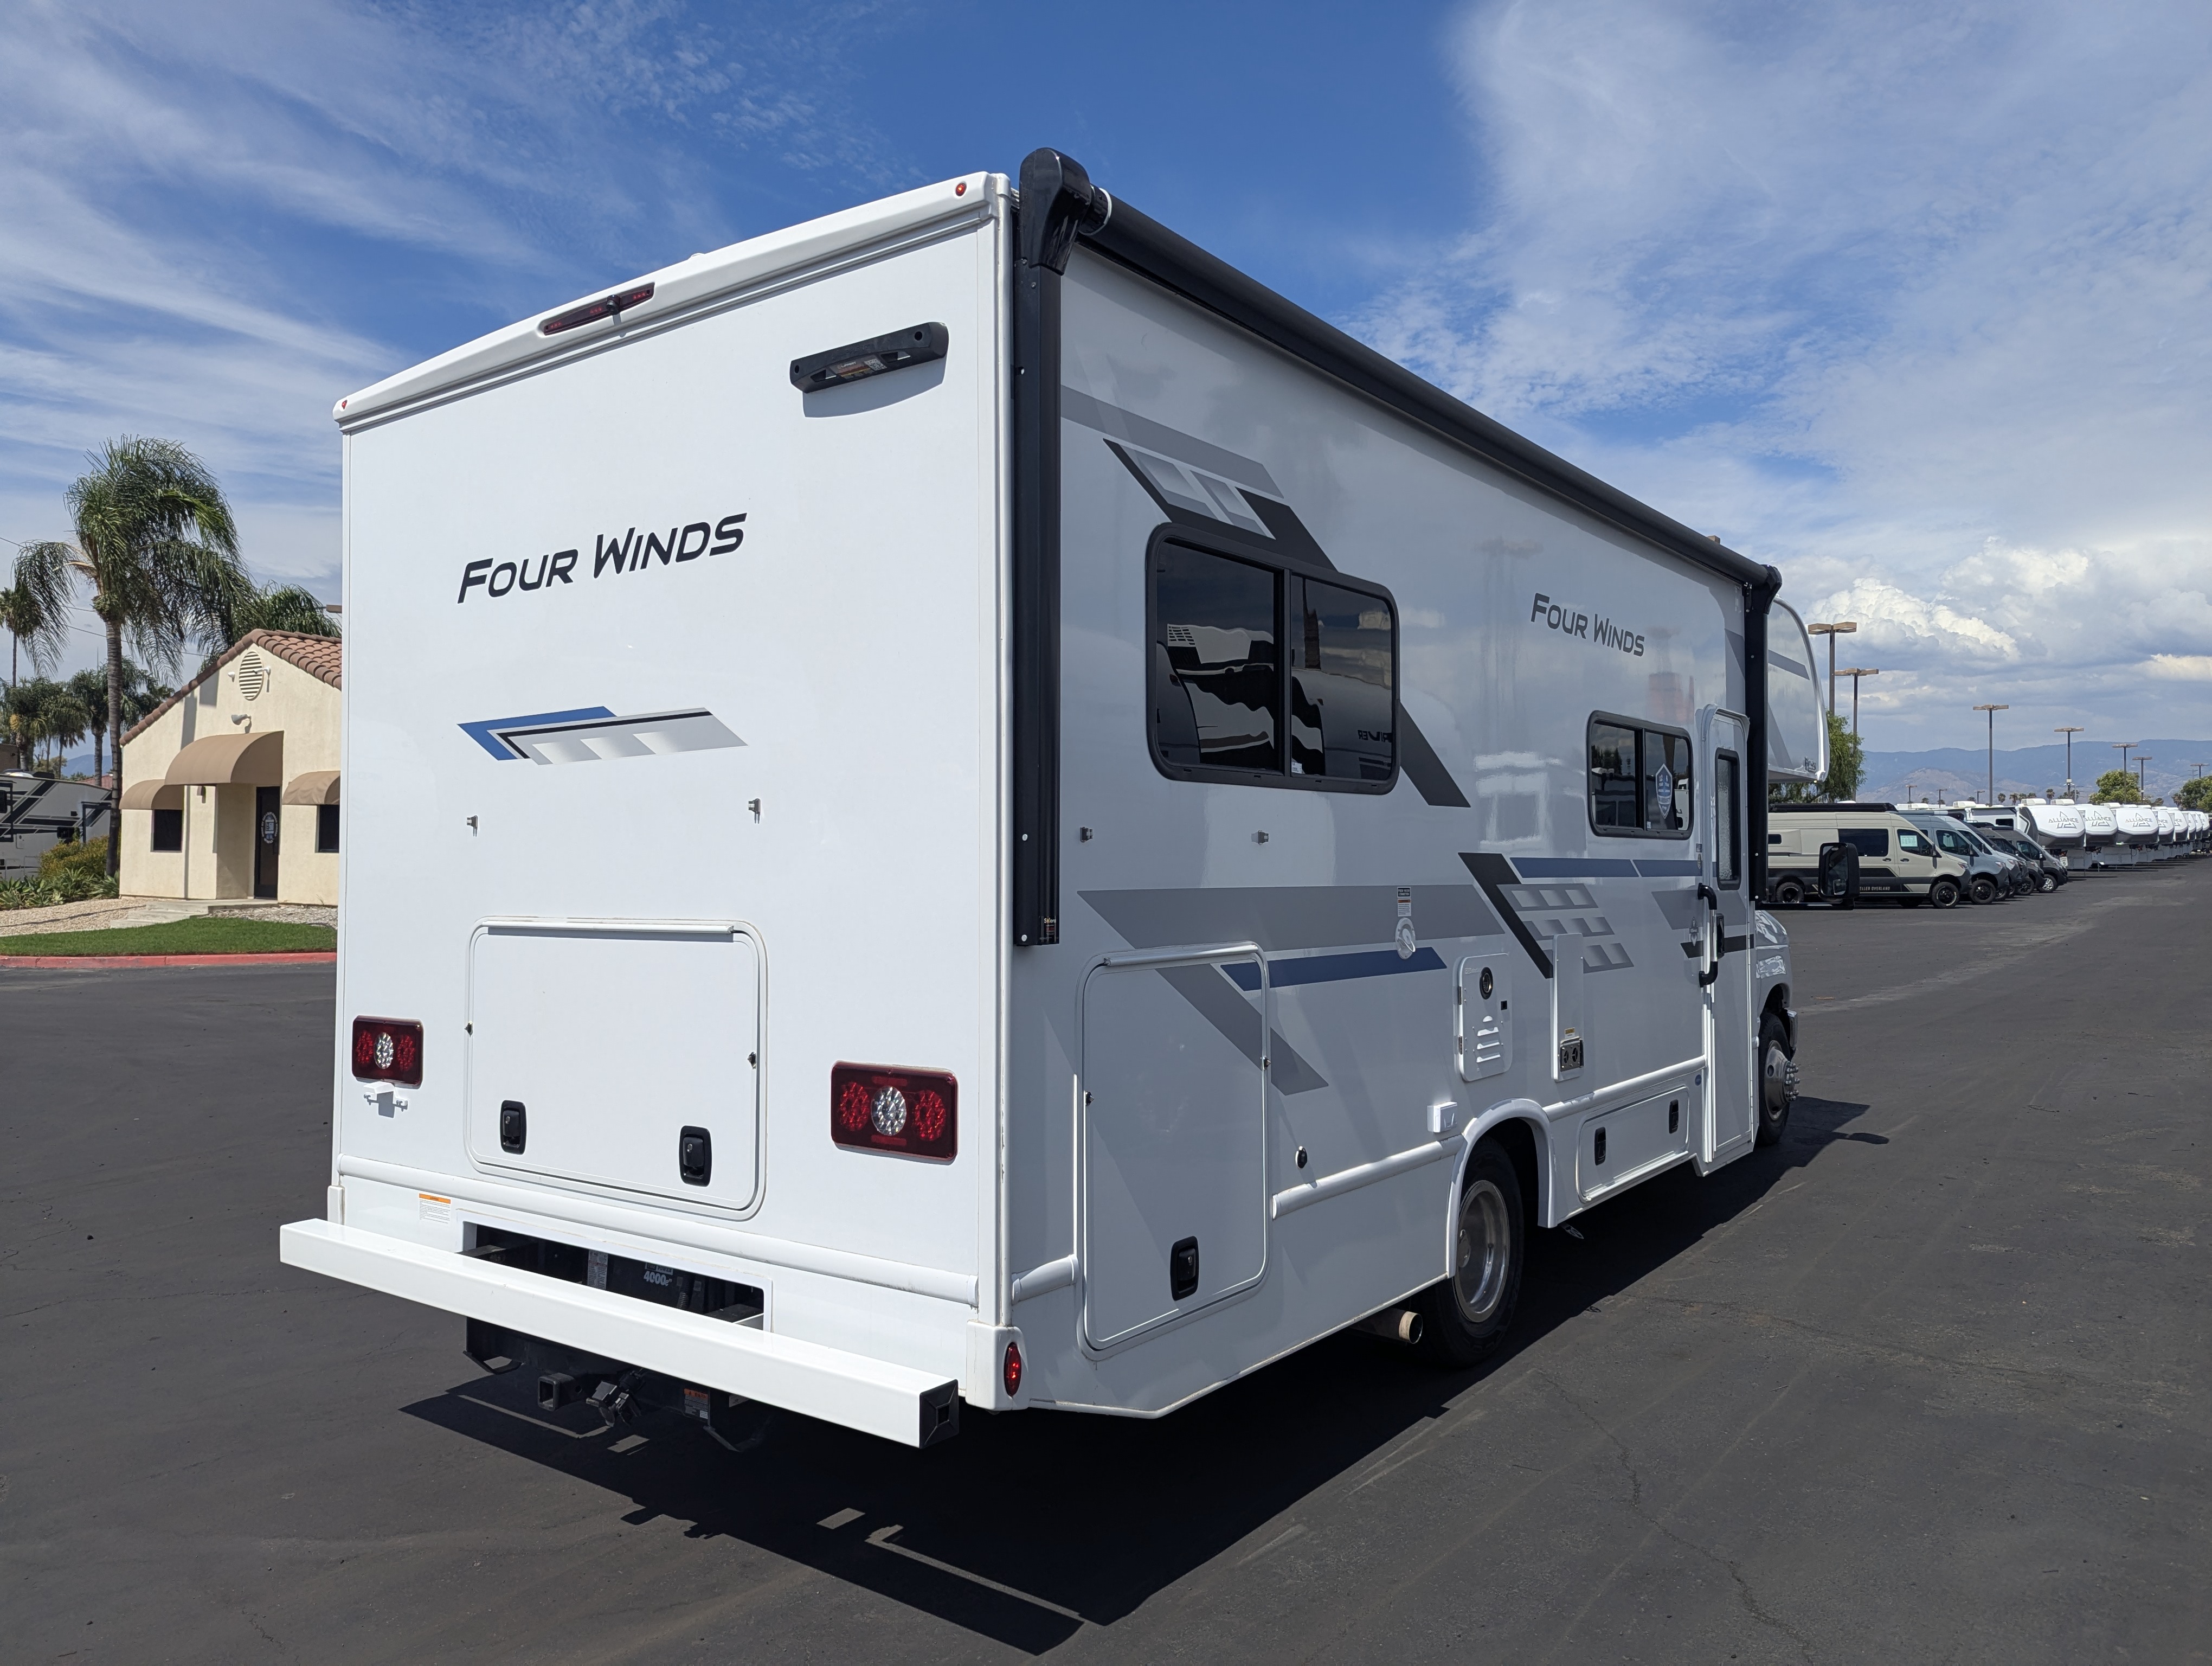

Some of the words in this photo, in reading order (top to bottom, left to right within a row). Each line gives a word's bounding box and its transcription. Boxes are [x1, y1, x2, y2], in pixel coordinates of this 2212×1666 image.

[457, 549, 578, 604] FOUR
[593, 512, 748, 579] WINDS
[1531, 592, 1588, 639] FOUR
[1593, 613, 1645, 657] WINDS
